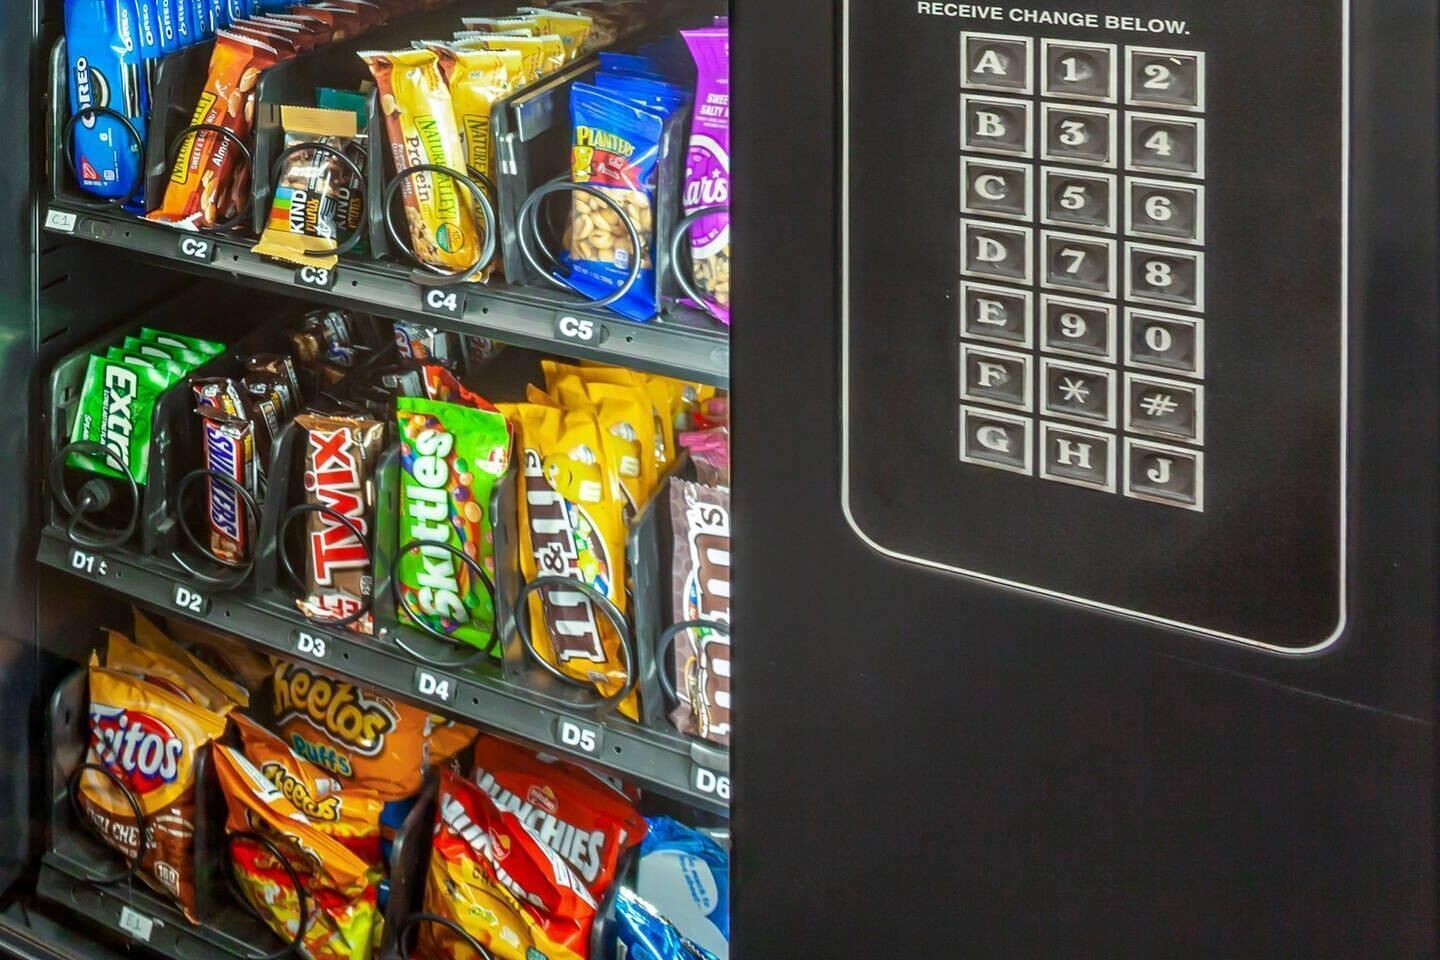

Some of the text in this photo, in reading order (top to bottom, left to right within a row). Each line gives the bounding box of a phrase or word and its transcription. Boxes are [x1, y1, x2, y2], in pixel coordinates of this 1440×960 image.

[917, 0, 1190, 35] RECEIVE CHANGE BELOW.
[973, 50, 1007, 75] A
[1062, 58, 1079, 82] 1
[1144, 64, 1171, 90] 2
[706, 93, 728, 104] SWEE
[976, 112, 1006, 138] B
[1060, 120, 1086, 146] 3
[1145, 130, 1172, 156] 4
[406, 136, 430, 202] Proein
[975, 174, 1006, 200] C
[1060, 186, 1086, 210] 5
[291, 190, 308, 234] KIND
[1145, 196, 1172, 222] 6
[182, 238, 208, 259] C2
[976, 236, 1008, 264] D
[1060, 249, 1086, 274] 7
[300, 267, 328, 286] C3
[1145, 261, 1172, 287] 8
[426, 290, 457, 311] C4
[977, 298, 1008, 326] E
[560, 317, 593, 340] C5
[1060, 312, 1086, 338] 9
[1145, 326, 1172, 352] 0
[978, 362, 1008, 388] F
[1140, 394, 1178, 416] #
[976, 426, 1010, 452] G
[1057, 438, 1092, 469] H
[1147, 458, 1174, 484] J
[407, 428, 470, 624] Skittles
[72, 552, 93, 572] D1
[176, 587, 202, 612] D2
[296, 632, 326, 658] D3
[418, 674, 448, 701] D4
[562, 724, 596, 752] D5
[290, 732, 352, 777] Puffs
[696, 771, 730, 798] D6
